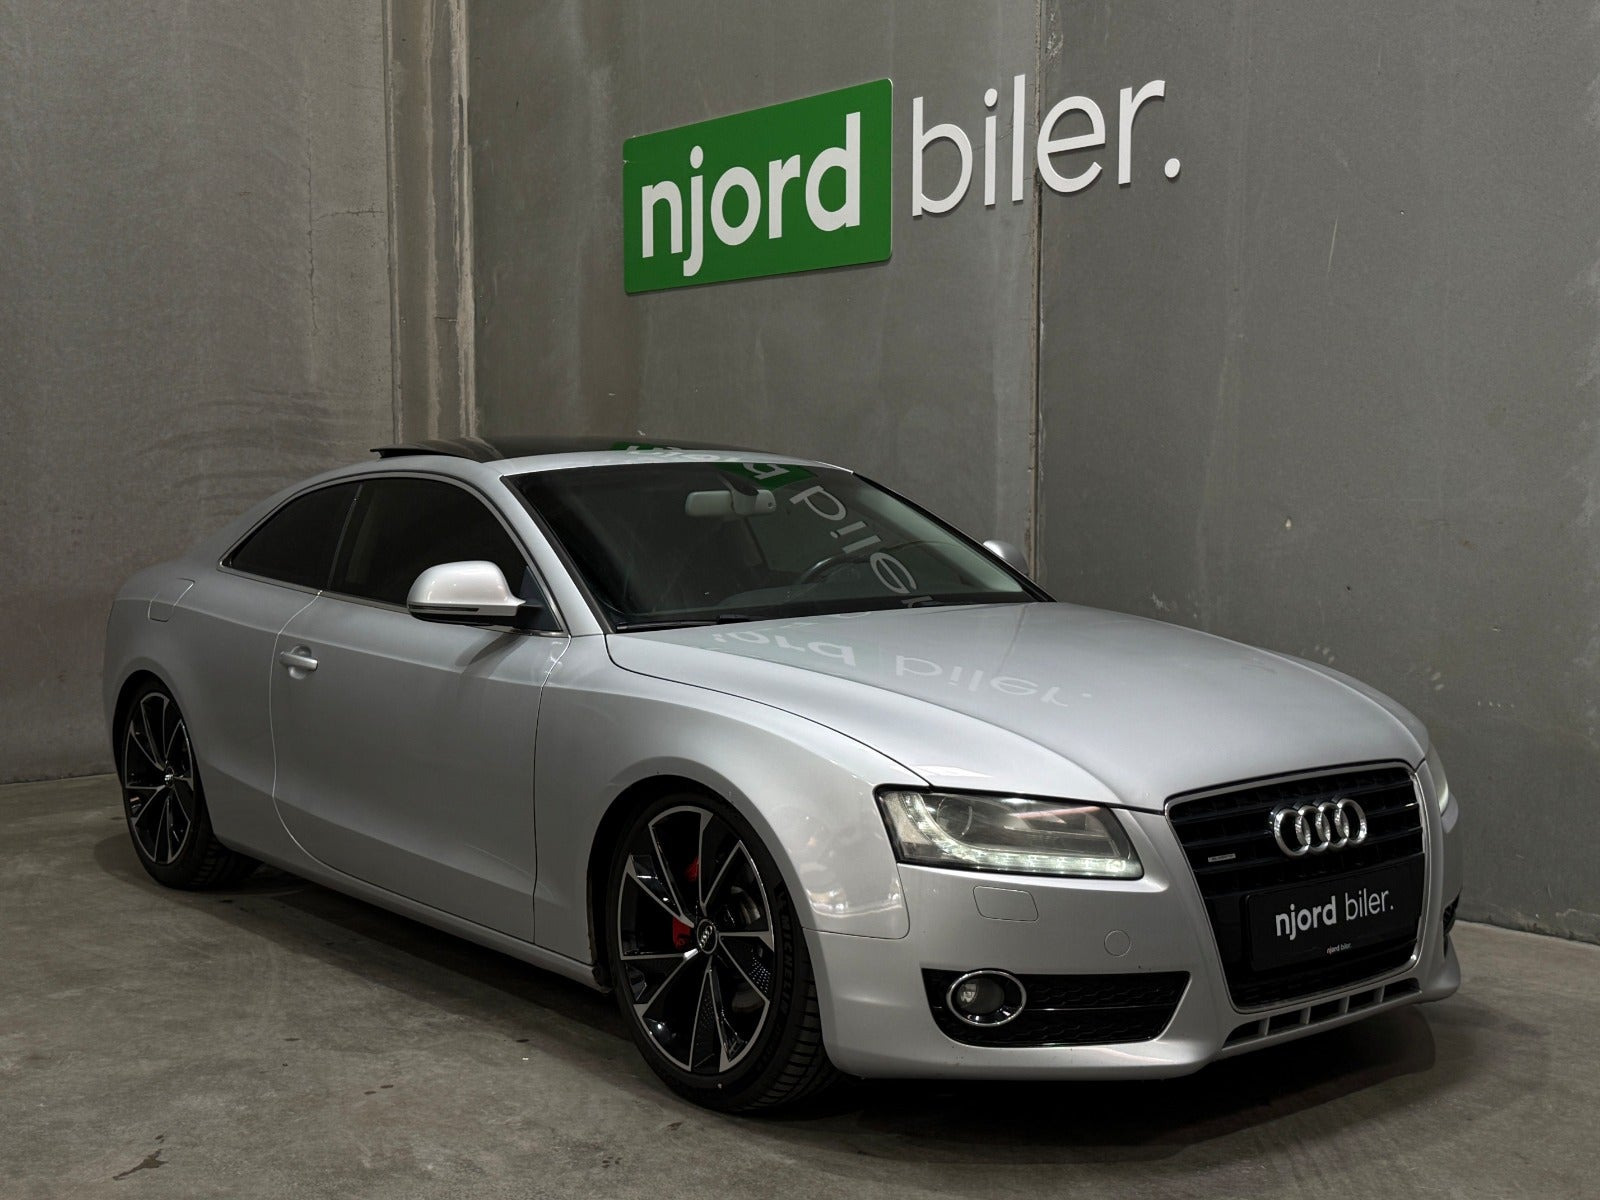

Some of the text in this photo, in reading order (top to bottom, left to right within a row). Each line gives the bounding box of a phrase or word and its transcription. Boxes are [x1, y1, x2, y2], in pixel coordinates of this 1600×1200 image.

[641, 73, 1181, 277] njord biler.
[1275, 887, 1394, 941] njord biler.
